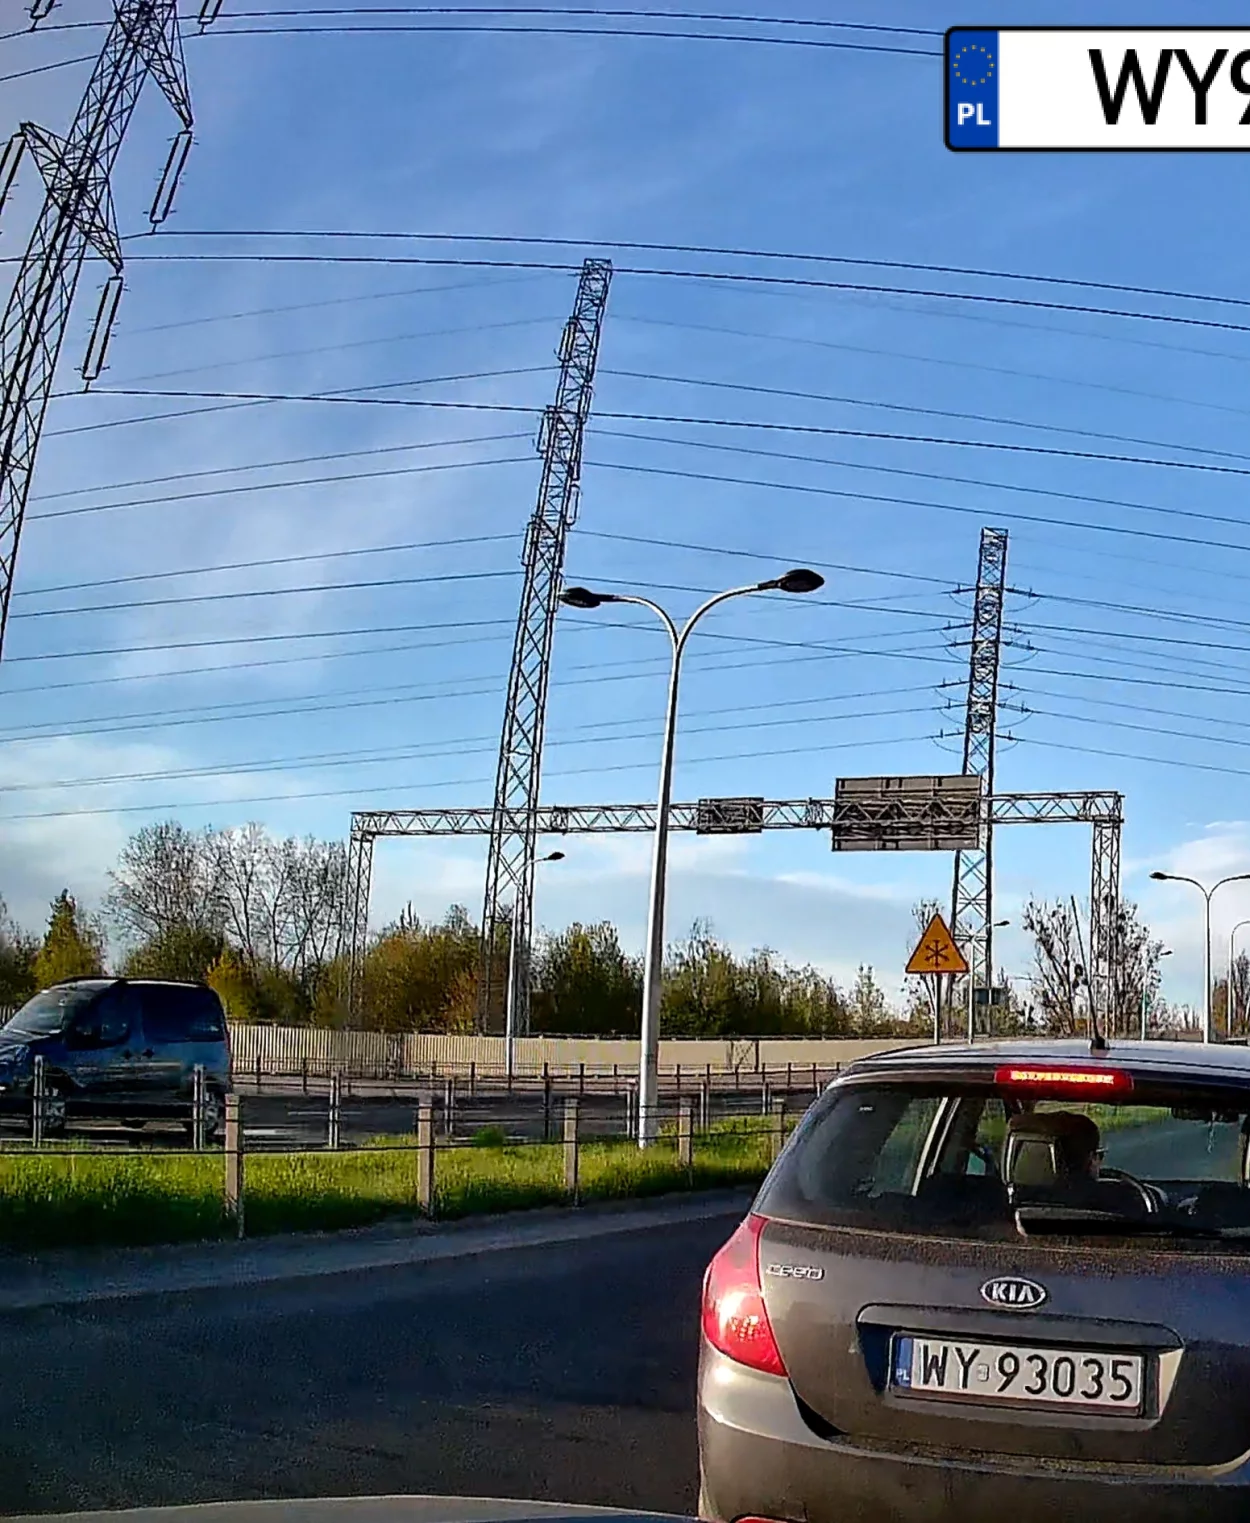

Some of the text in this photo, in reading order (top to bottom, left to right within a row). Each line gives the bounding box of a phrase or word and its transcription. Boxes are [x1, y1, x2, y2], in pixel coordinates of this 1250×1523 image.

[992, 1282, 1035, 1303] KIA
[896, 1368, 910, 1381] PL
[921, 1344, 1134, 1401] WY 93035
